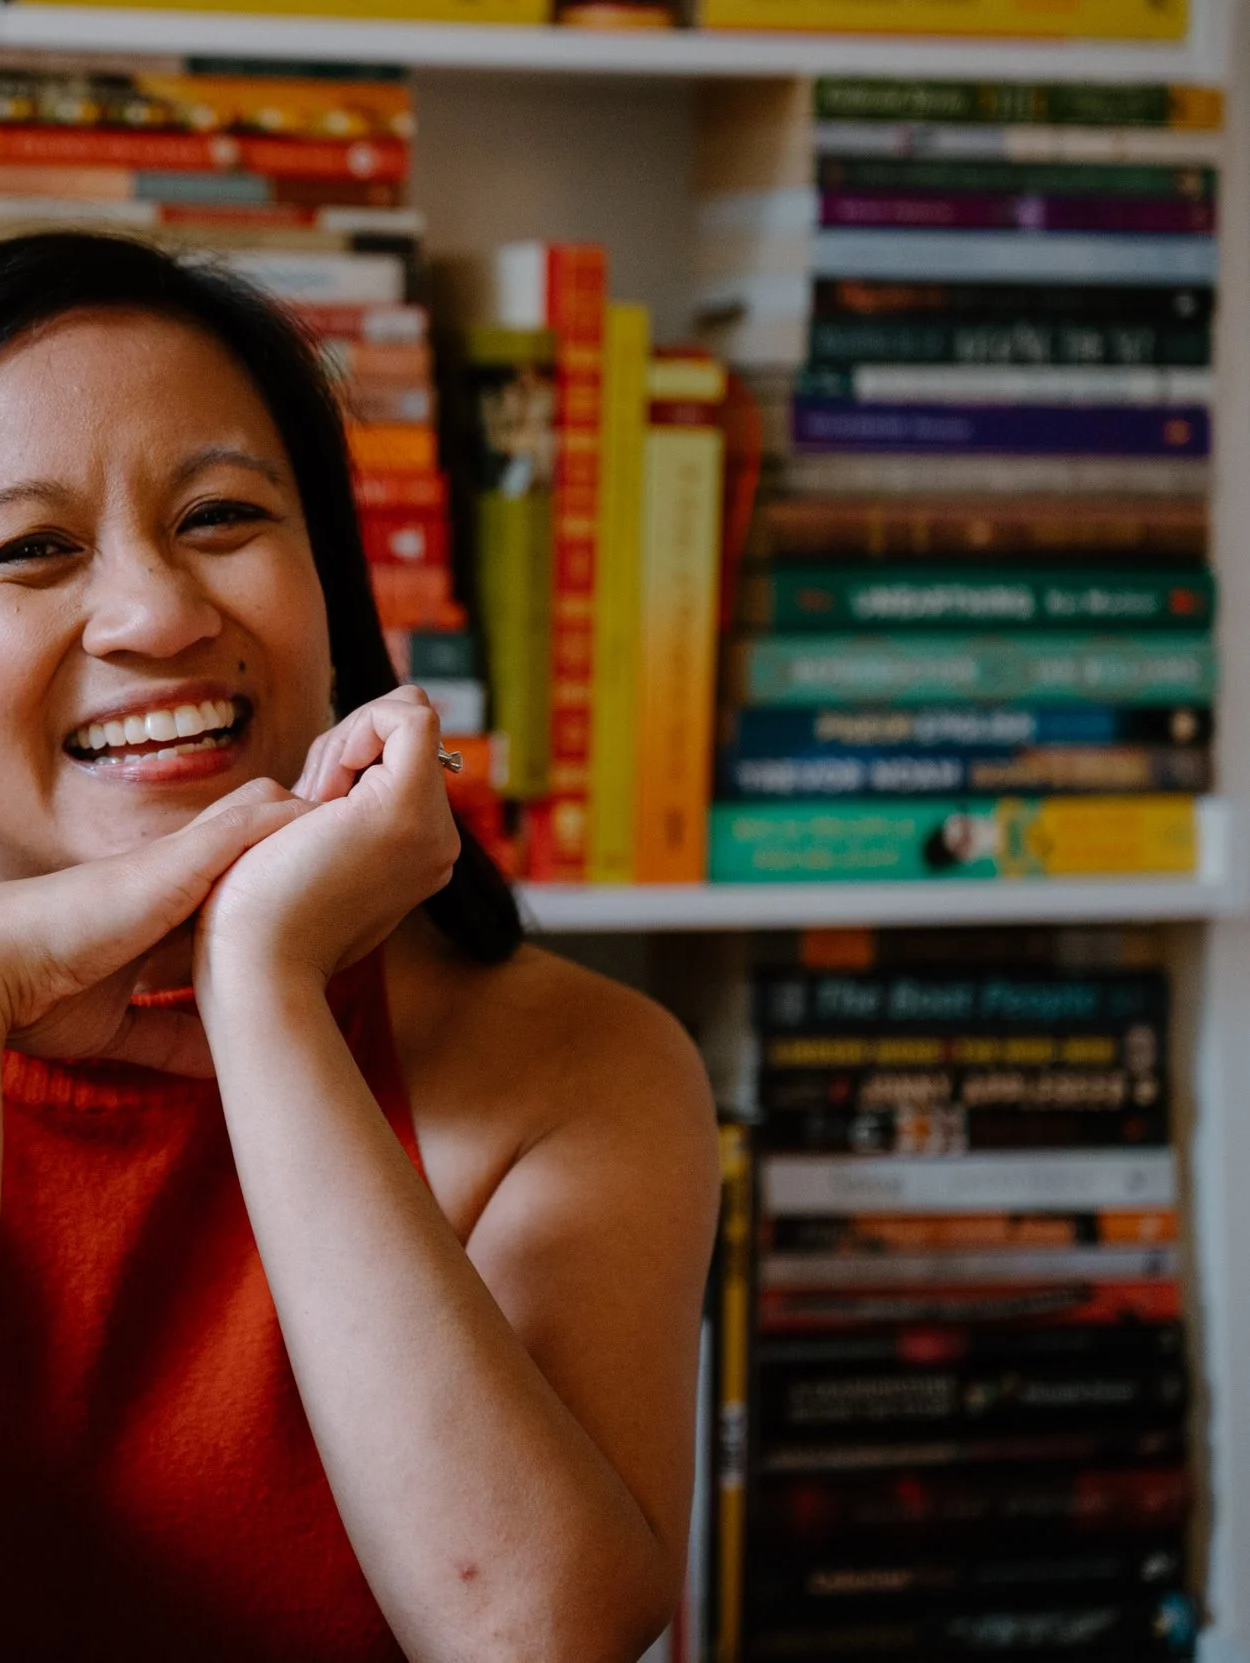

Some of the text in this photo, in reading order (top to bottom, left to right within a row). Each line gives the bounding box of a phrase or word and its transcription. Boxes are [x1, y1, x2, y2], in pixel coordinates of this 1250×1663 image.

[816, 983, 1100, 1024] The Boat People
